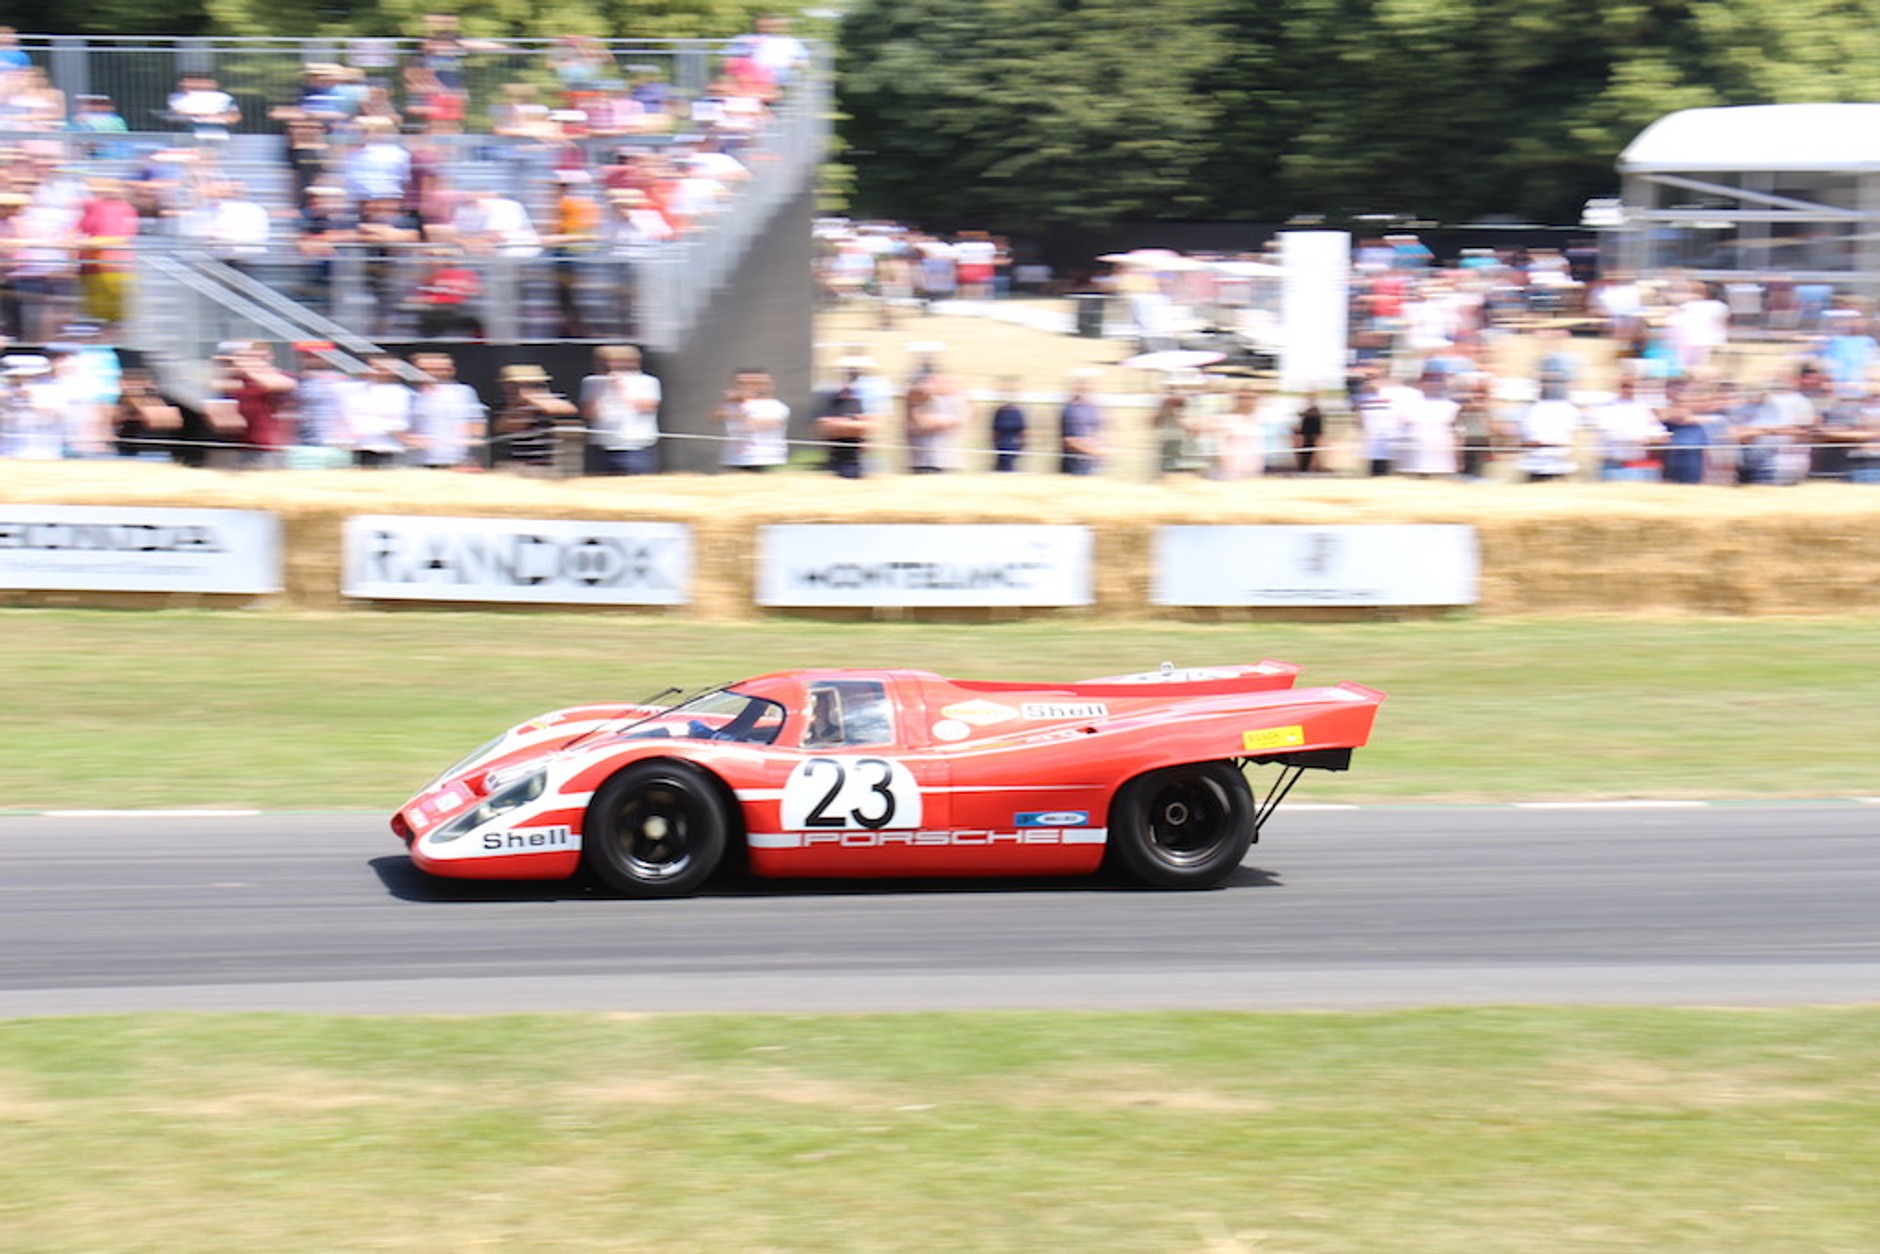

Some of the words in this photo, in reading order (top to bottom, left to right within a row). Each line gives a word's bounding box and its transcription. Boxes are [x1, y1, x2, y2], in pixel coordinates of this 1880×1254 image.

[362, 530, 682, 589] RANDOX
[1026, 703, 1105, 720] Shell
[802, 758, 896, 828] 23
[482, 827, 569, 850] Shell
[803, 828, 1062, 848] PORSCHE
